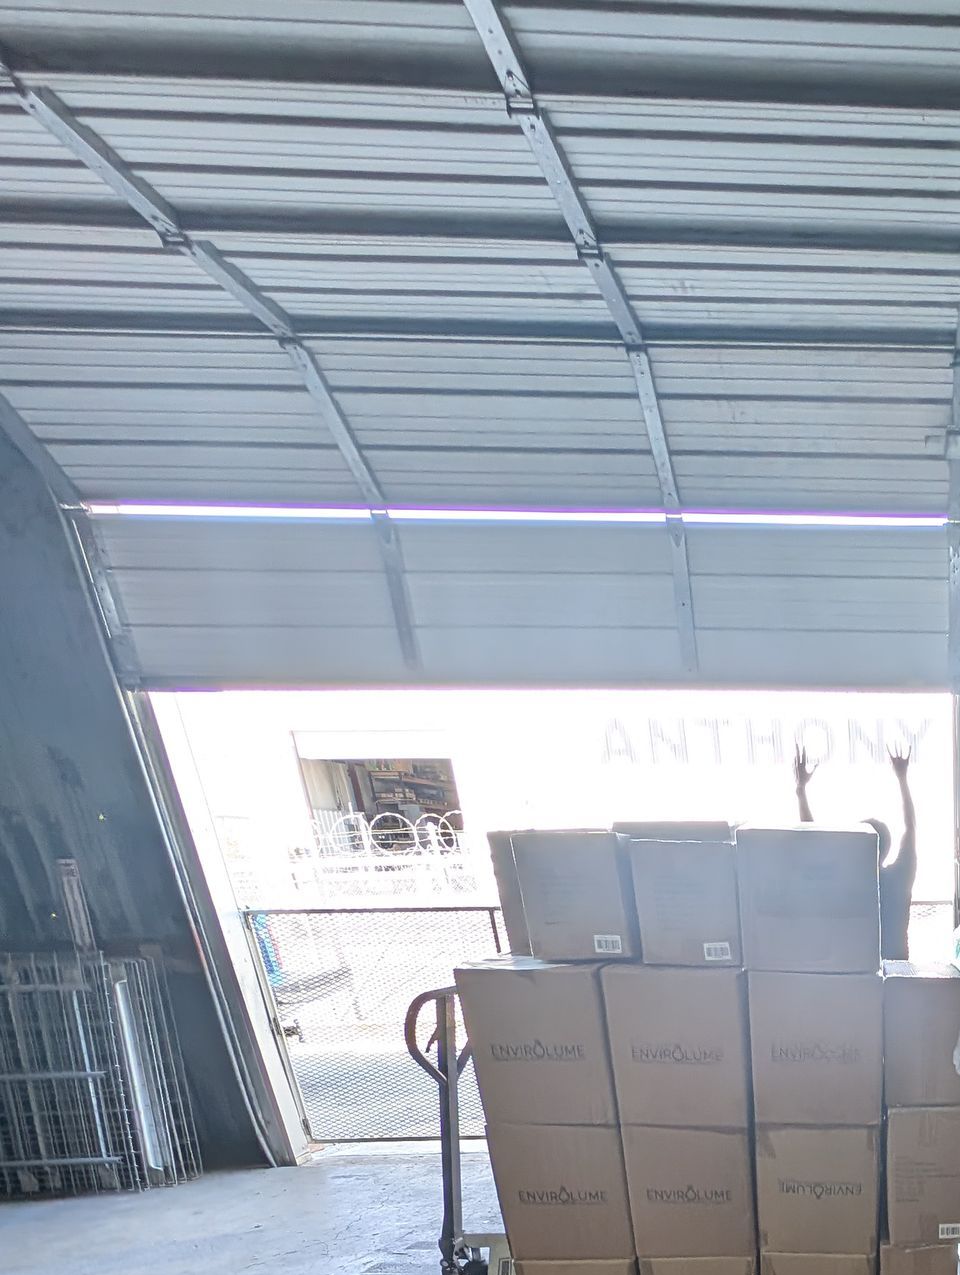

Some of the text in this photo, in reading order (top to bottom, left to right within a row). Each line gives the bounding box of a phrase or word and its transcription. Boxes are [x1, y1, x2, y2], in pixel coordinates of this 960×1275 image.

[601, 717, 932, 765] ANTHONY
[490, 1038, 585, 1059] ENVIROLUME
[518, 1185, 607, 1203] ENVIROLUME
[646, 1184, 732, 1202] ENVIROLUME
